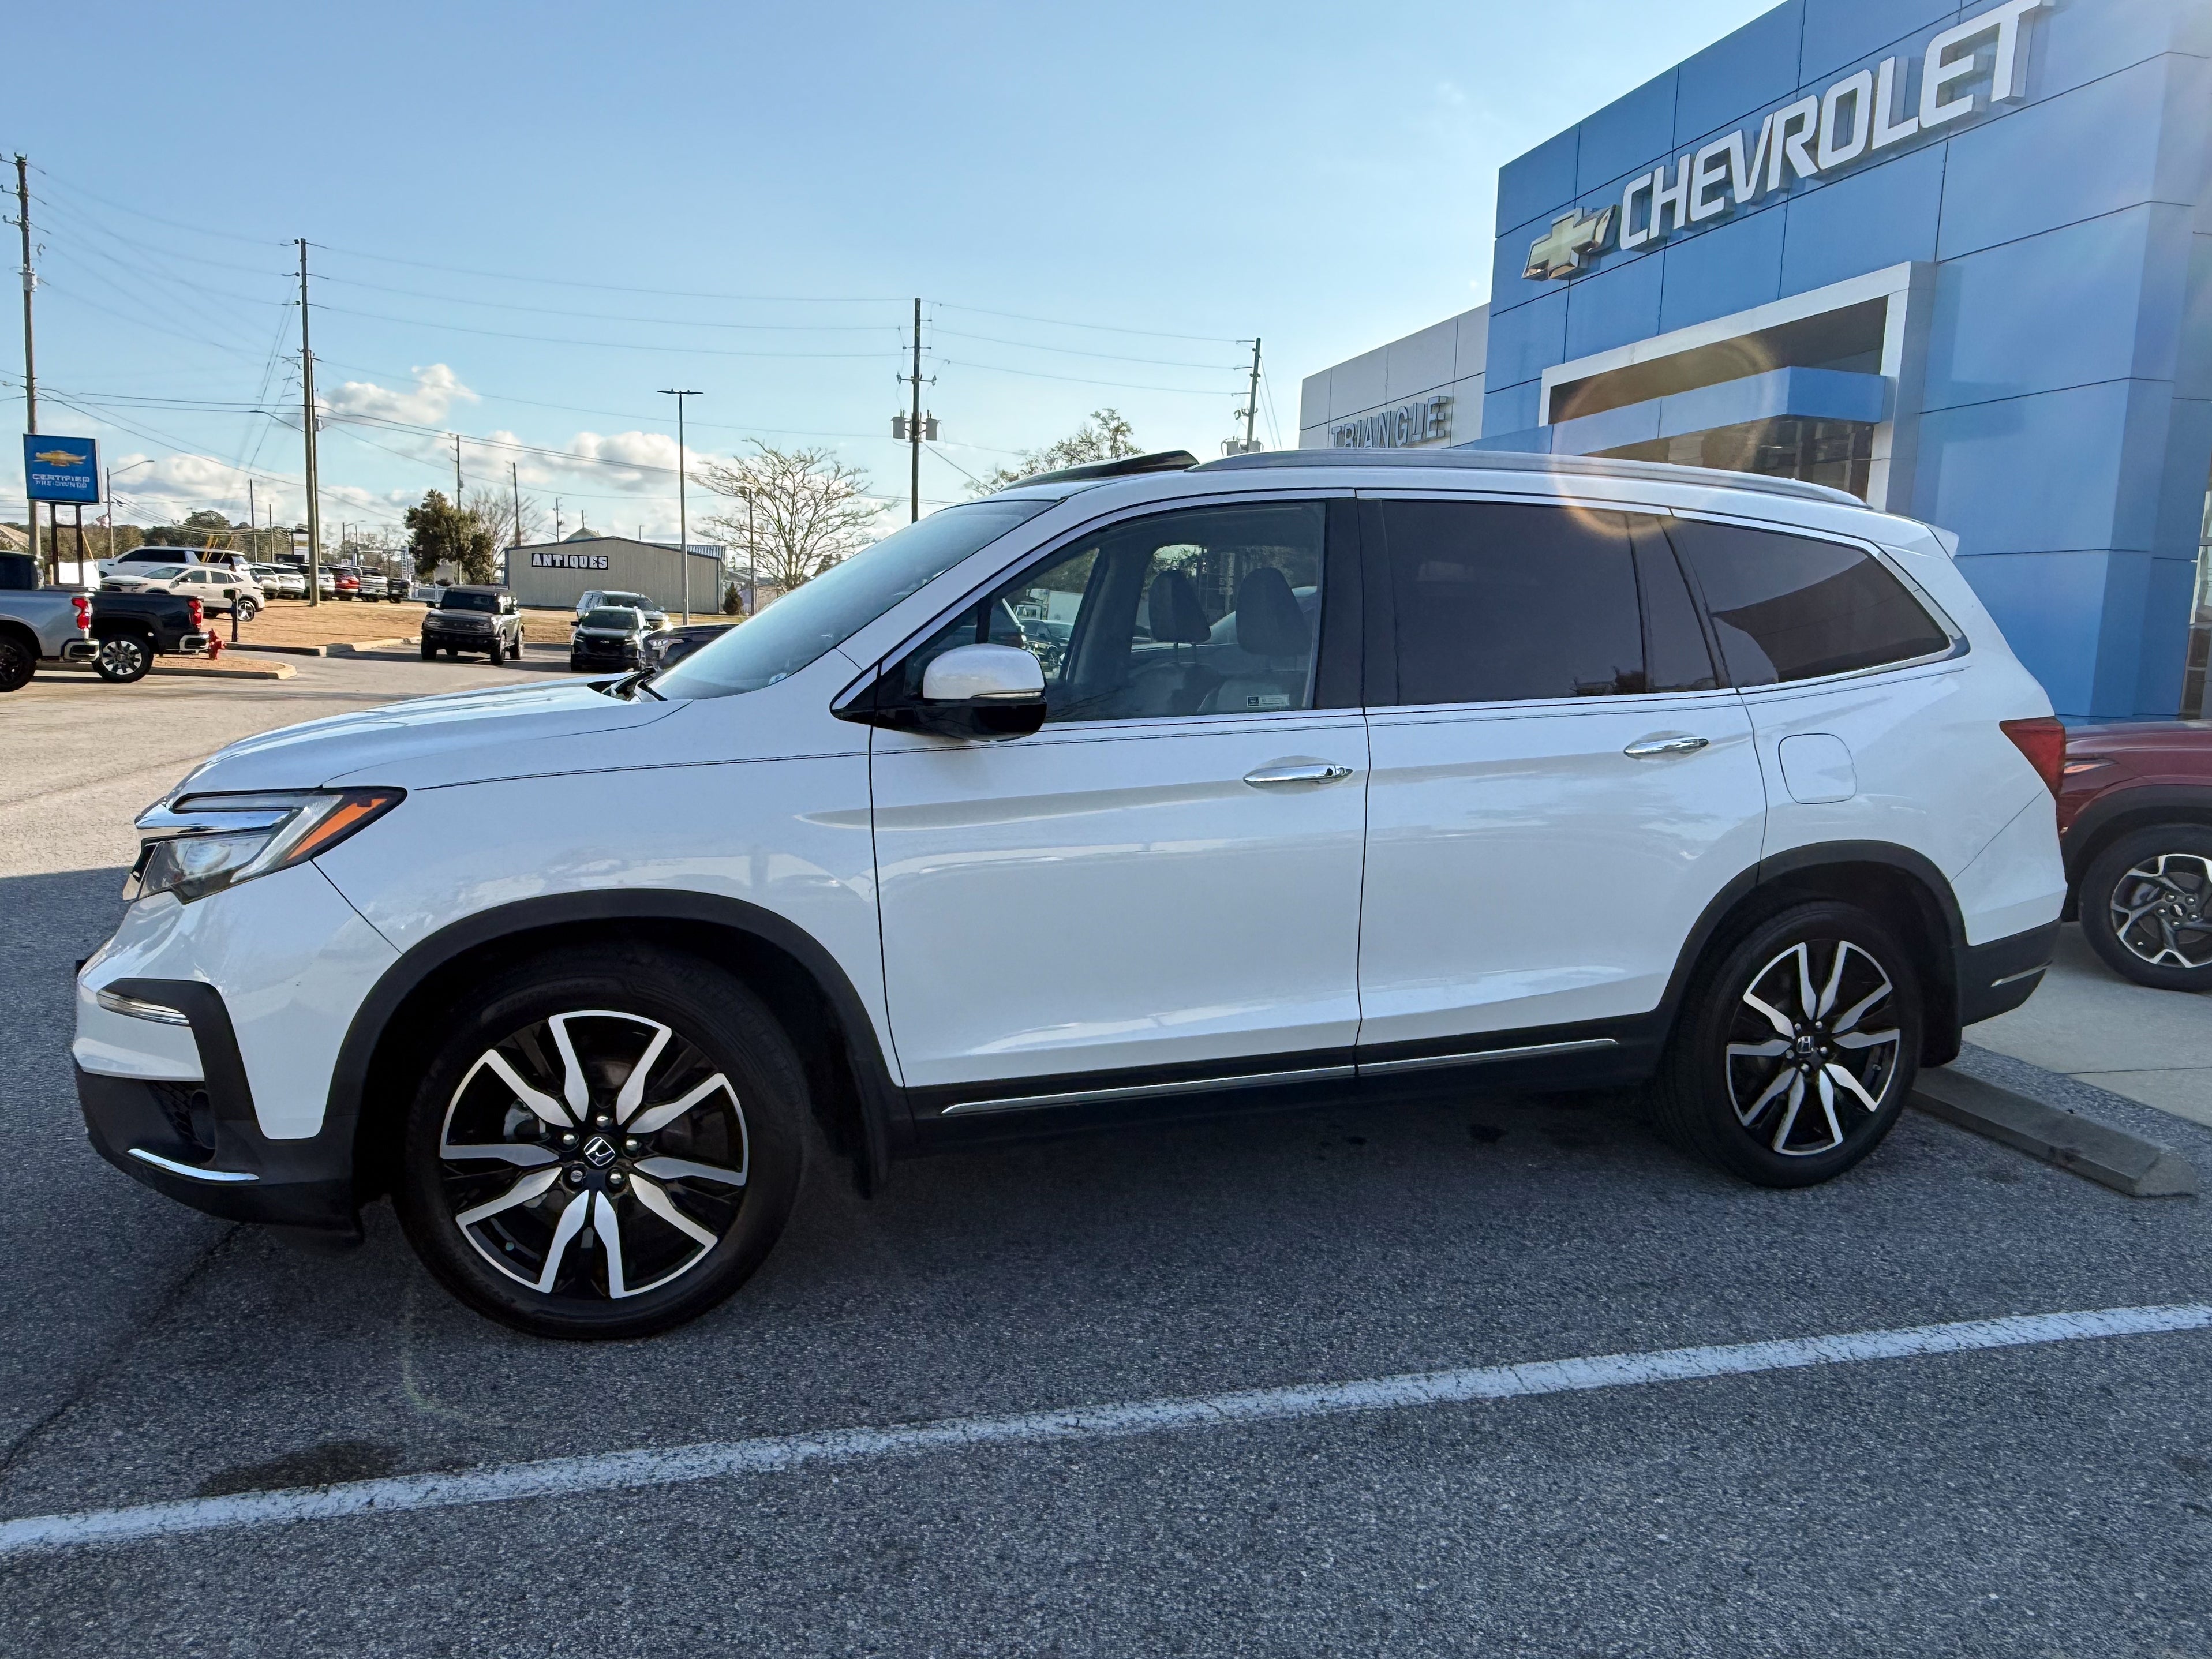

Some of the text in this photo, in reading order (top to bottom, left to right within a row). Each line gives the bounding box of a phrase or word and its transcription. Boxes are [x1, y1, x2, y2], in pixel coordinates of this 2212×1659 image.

[1620, 0, 2042, 250] CHEVROLET
[1331, 396, 1446, 448] TRIANGLE
[32, 474, 90, 482] CERTIFIED
[532, 553, 607, 568] ANTIQUES
